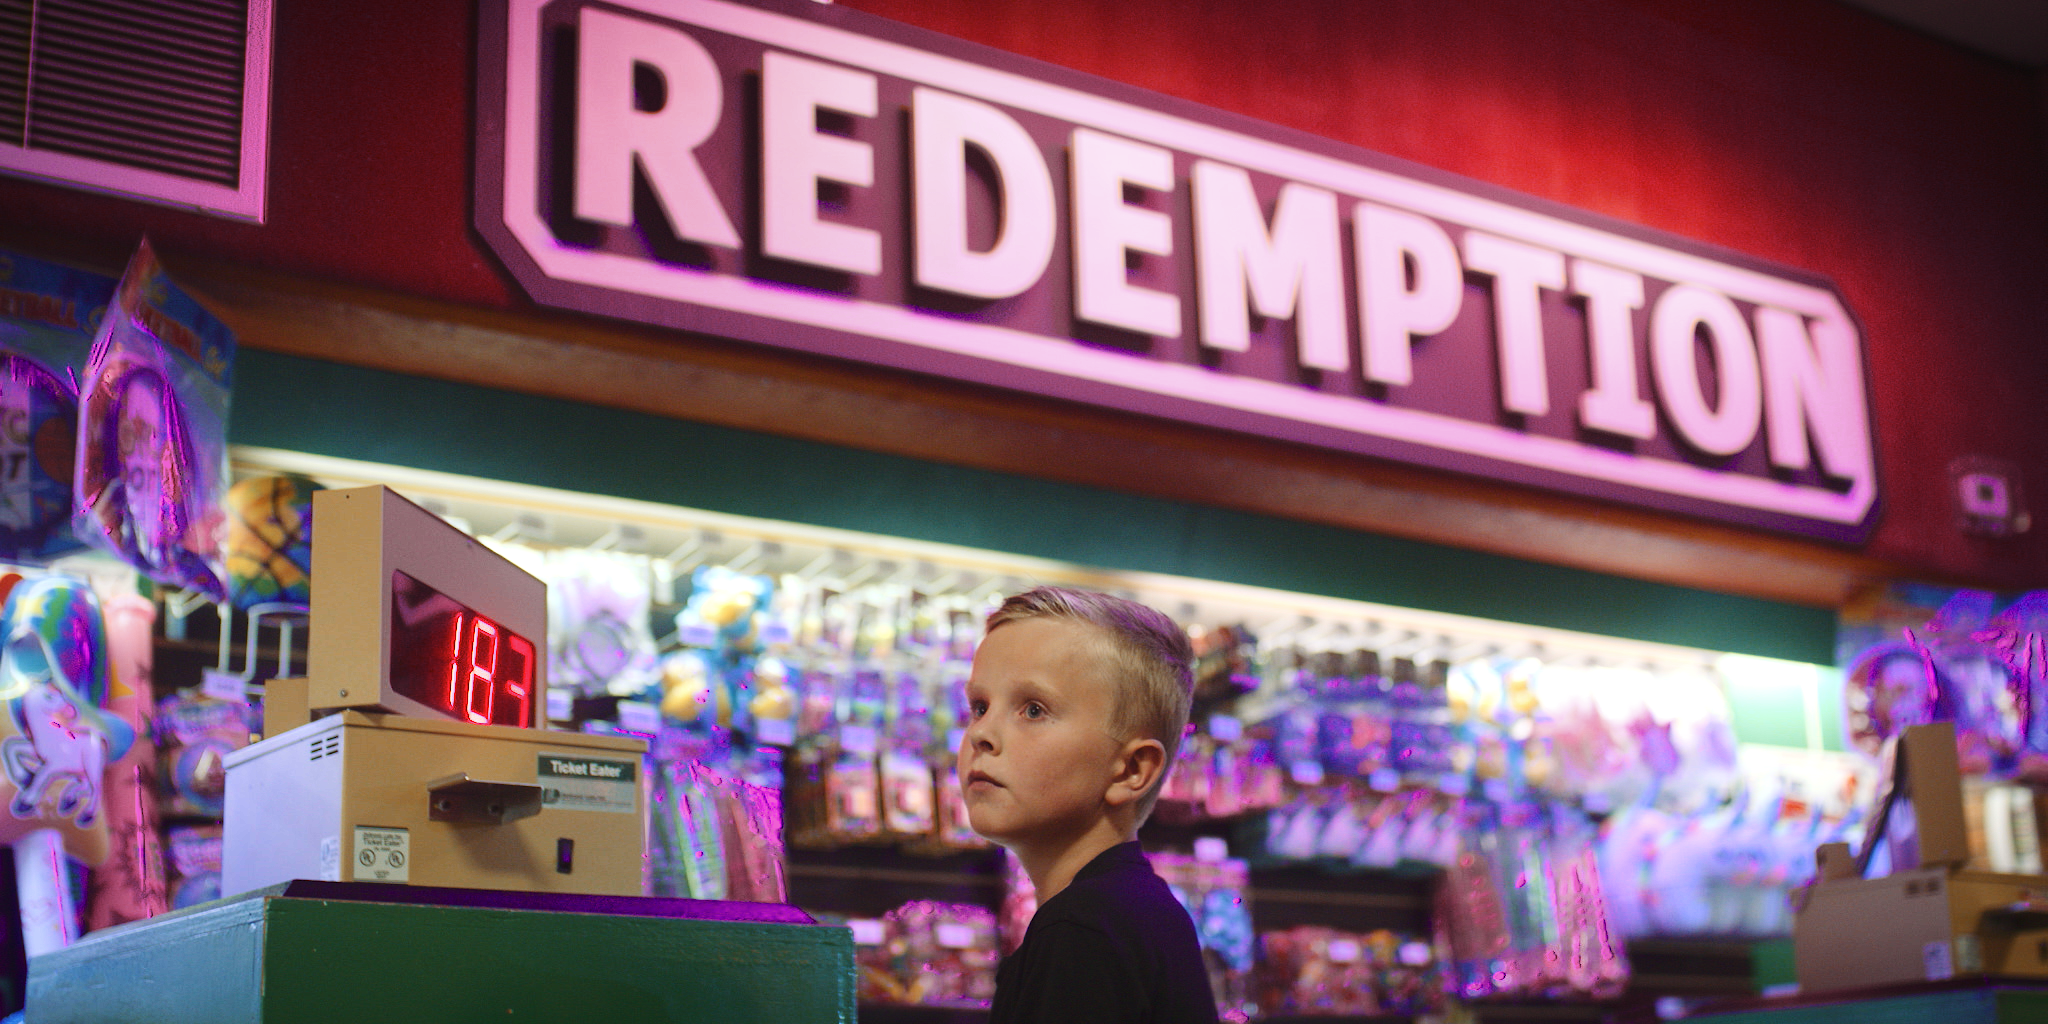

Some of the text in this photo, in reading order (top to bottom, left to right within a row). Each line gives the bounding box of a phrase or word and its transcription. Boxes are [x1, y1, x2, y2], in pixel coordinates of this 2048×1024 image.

[573, 8, 1856, 480] REDEMPTION
[550, 759, 622, 778] Ticket Eater
